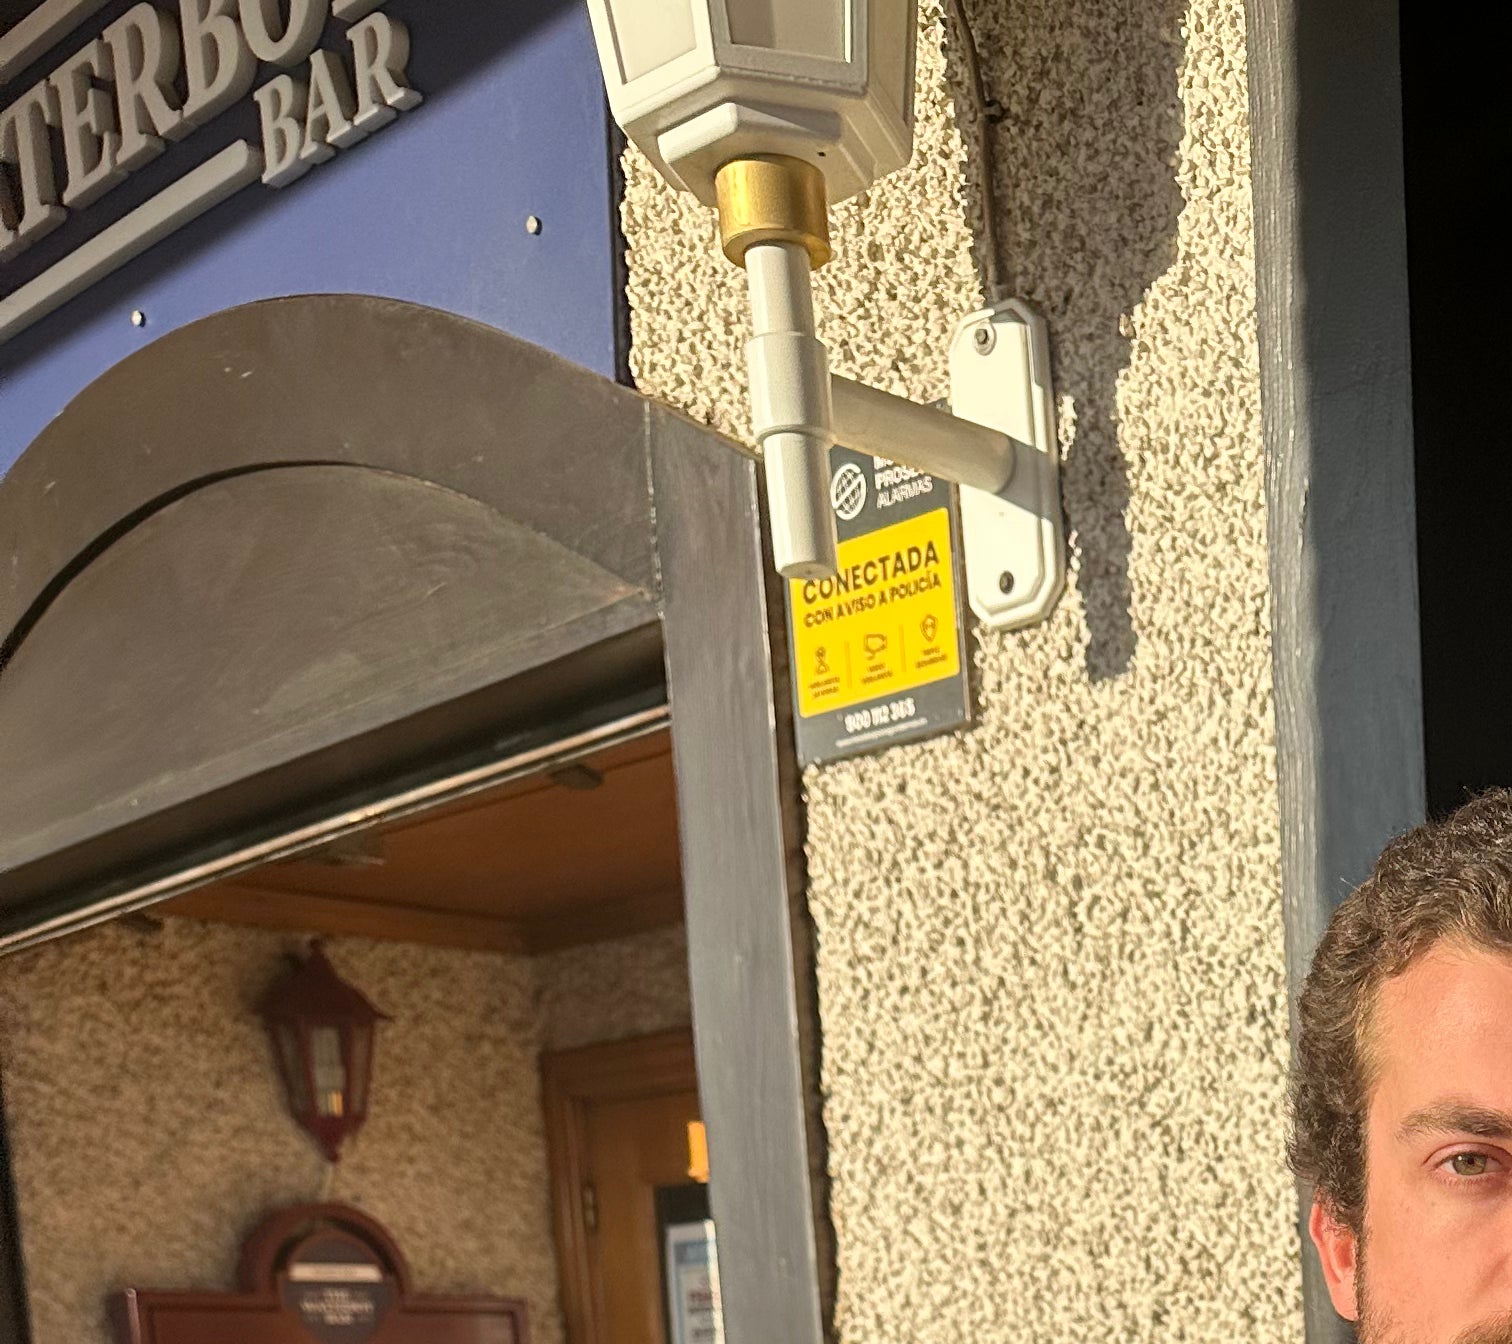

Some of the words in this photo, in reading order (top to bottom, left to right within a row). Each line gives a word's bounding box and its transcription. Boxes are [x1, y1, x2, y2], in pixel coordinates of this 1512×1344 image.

[253, 11, 421, 188] BAR
[803, 540, 940, 604] CONECTADA
[804, 606, 834, 628] CON
[836, 593, 876, 619] AVISO
[878, 590, 889, 606] A
